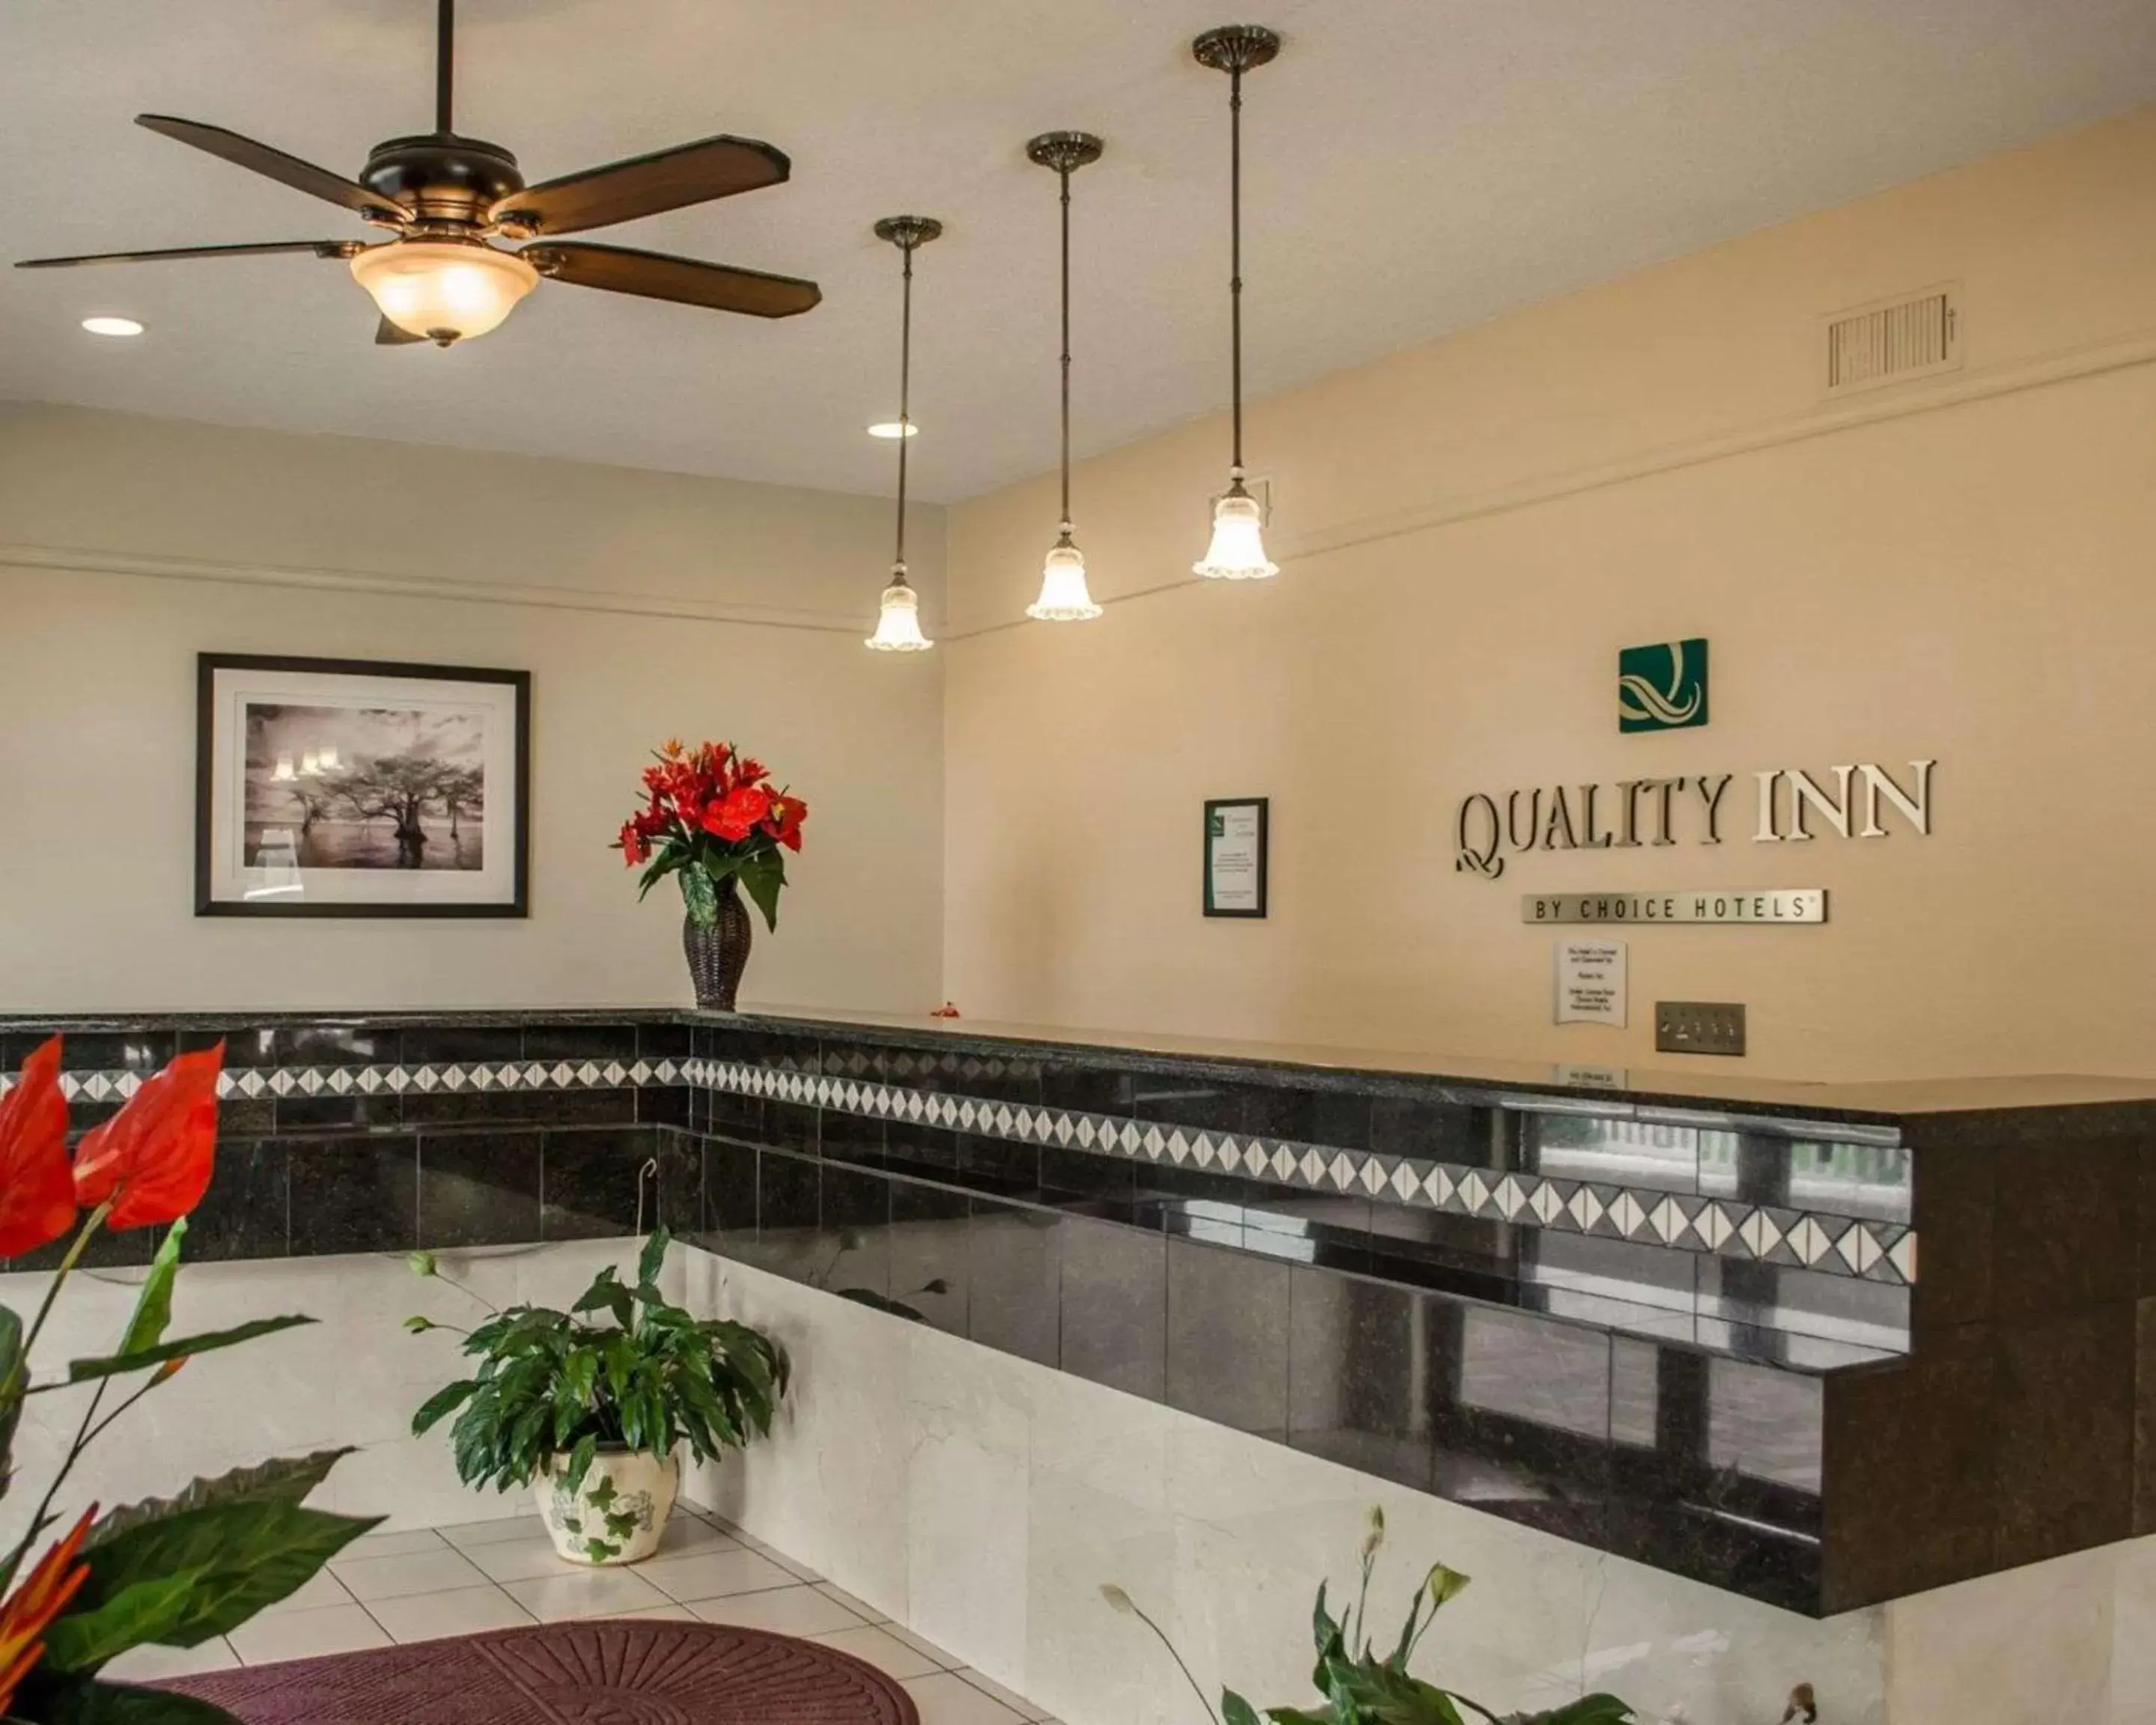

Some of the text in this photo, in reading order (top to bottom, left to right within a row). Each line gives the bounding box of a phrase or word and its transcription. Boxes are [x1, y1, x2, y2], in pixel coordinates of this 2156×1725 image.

[1454, 758, 1937, 880] QUALITY INN
[1535, 897, 1805, 919] BY CHOICE HOTELS
